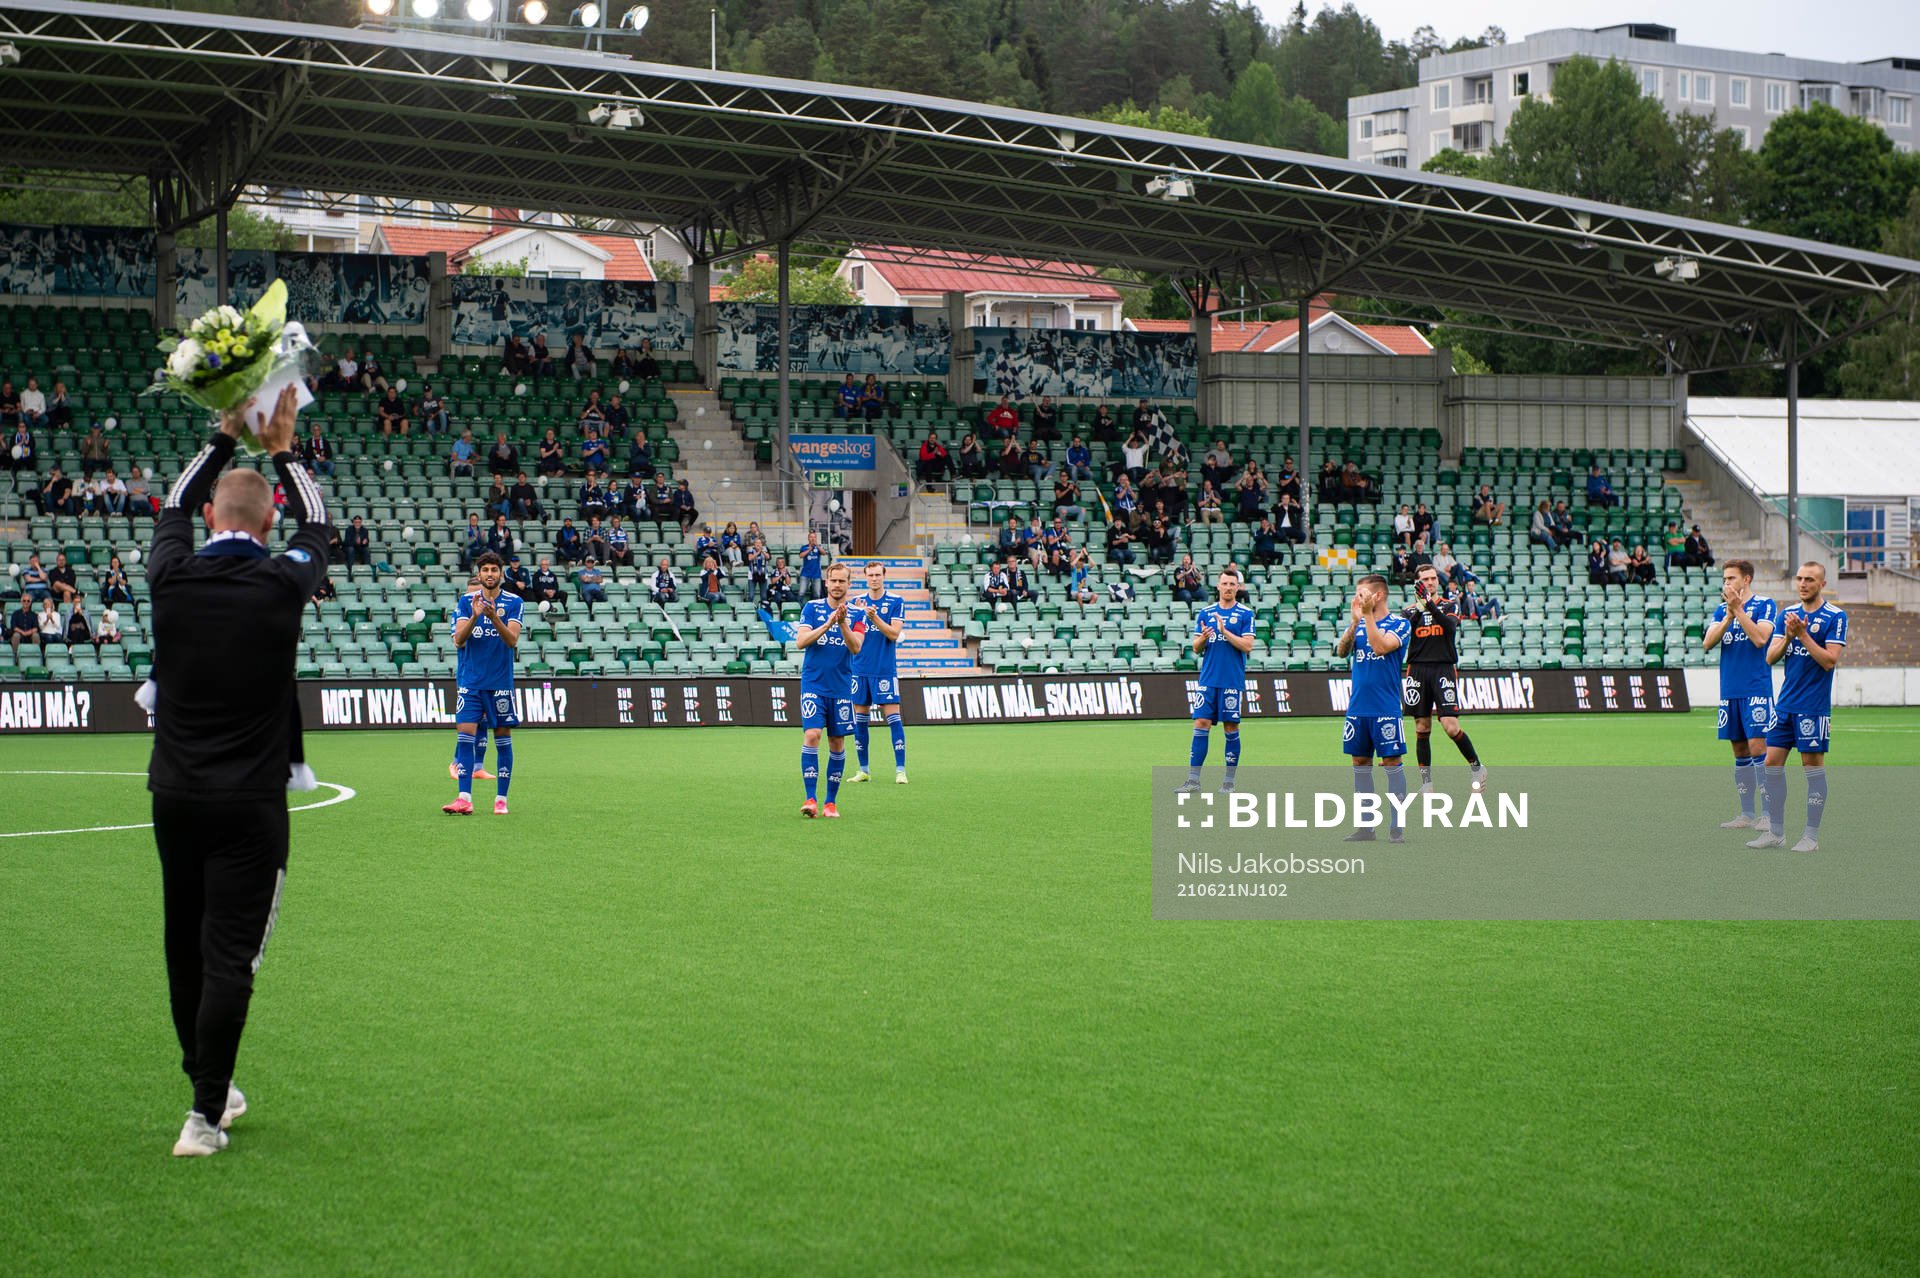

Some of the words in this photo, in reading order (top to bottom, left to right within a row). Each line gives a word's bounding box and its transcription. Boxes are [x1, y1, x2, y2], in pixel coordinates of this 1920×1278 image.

[485, 628, 500, 637] SC
[45, 685, 91, 728] MÄ?
[321, 689, 363, 725] MOT
[367, 688, 407, 724] NYA
[525, 682, 568, 723] MÄ?
[923, 685, 962, 720] MOT
[963, 684, 1002, 719] NYA
[1000, 678, 1045, 718] MÅL.
[1044, 681, 1105, 718] SKARU
[1104, 676, 1143, 716] MÄ?
[1328, 679, 1352, 712] MO
[1498, 672, 1535, 710] MÄ?
